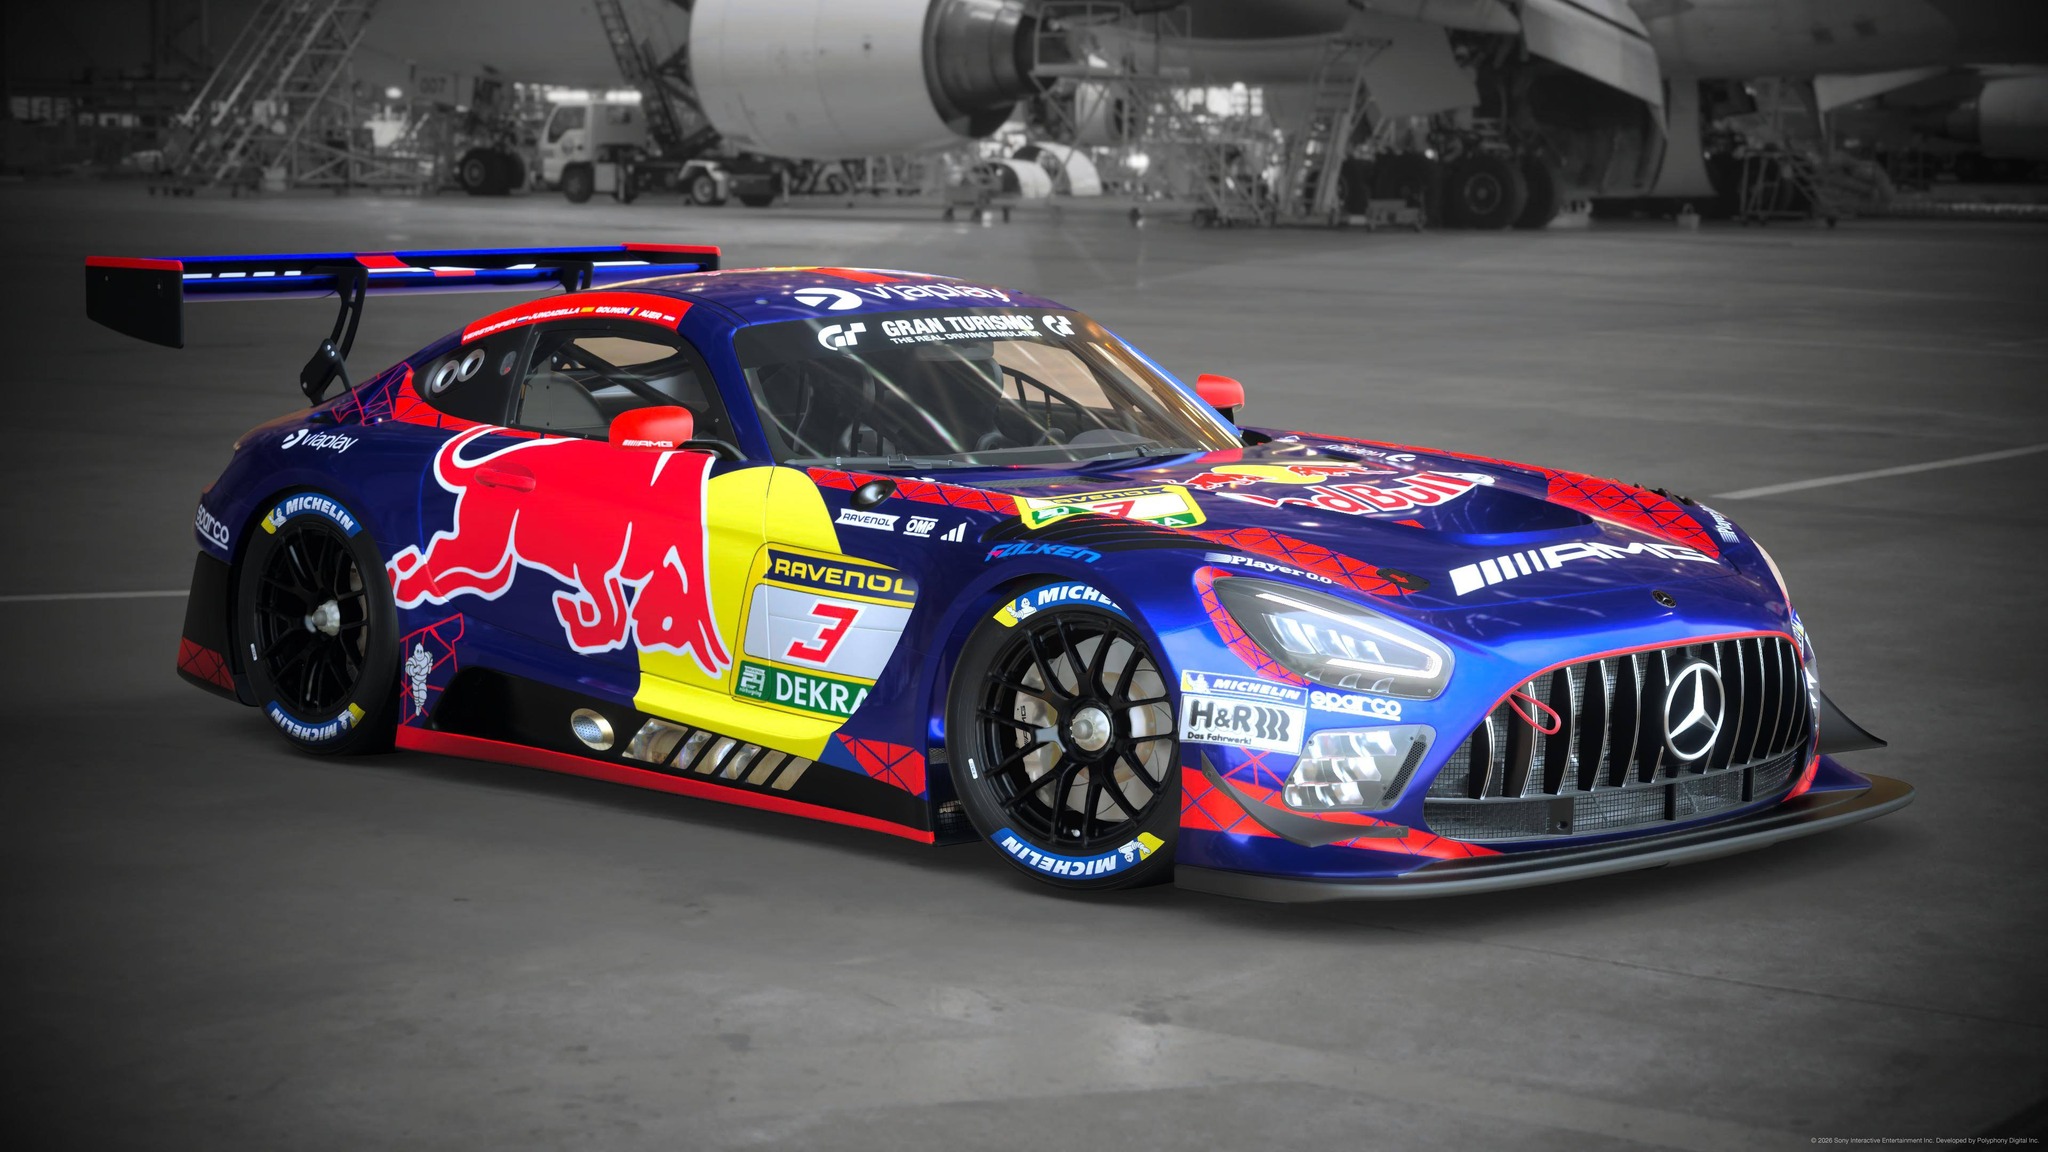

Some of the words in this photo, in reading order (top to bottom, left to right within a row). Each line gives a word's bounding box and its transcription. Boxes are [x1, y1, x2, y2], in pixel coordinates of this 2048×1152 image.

[855, 283, 1010, 302] viaplay
[463, 317, 518, 341] VERSTAPPEN
[595, 306, 630, 315] GOUNON
[637, 309, 663, 321] AUER
[882, 318, 946, 338] GRAN
[890, 337, 916, 345] THE
[914, 334, 946, 342] REAL
[945, 331, 988, 340] DRIVING
[988, 329, 1043, 338] SIMULATOR
[301, 431, 359, 454] viaplay
[1051, 488, 1161, 505] AVENOL
[1332, 472, 1478, 513] Bull
[195, 504, 230, 545] sparco
[285, 496, 355, 531] MICHELIN
[842, 512, 891, 527] RAVENOL
[905, 517, 937, 534] OMP
[984, 543, 1102, 564] FALKEN
[1540, 542, 1721, 571] AMG
[774, 557, 915, 597] RAVENOL
[1230, 555, 1305, 577] Player
[1305, 572, 1333, 585] 0.0
[785, 602, 860, 664] 3
[1212, 678, 1301, 700] MICHELIN
[271, 707, 338, 741] MICHELIN
[1190, 699, 1252, 732] H&R
[1187, 731, 1205, 741] Das
[1206, 733, 1252, 745] Fahrwerk!
[1000, 836, 1117, 876] MICHELIN
